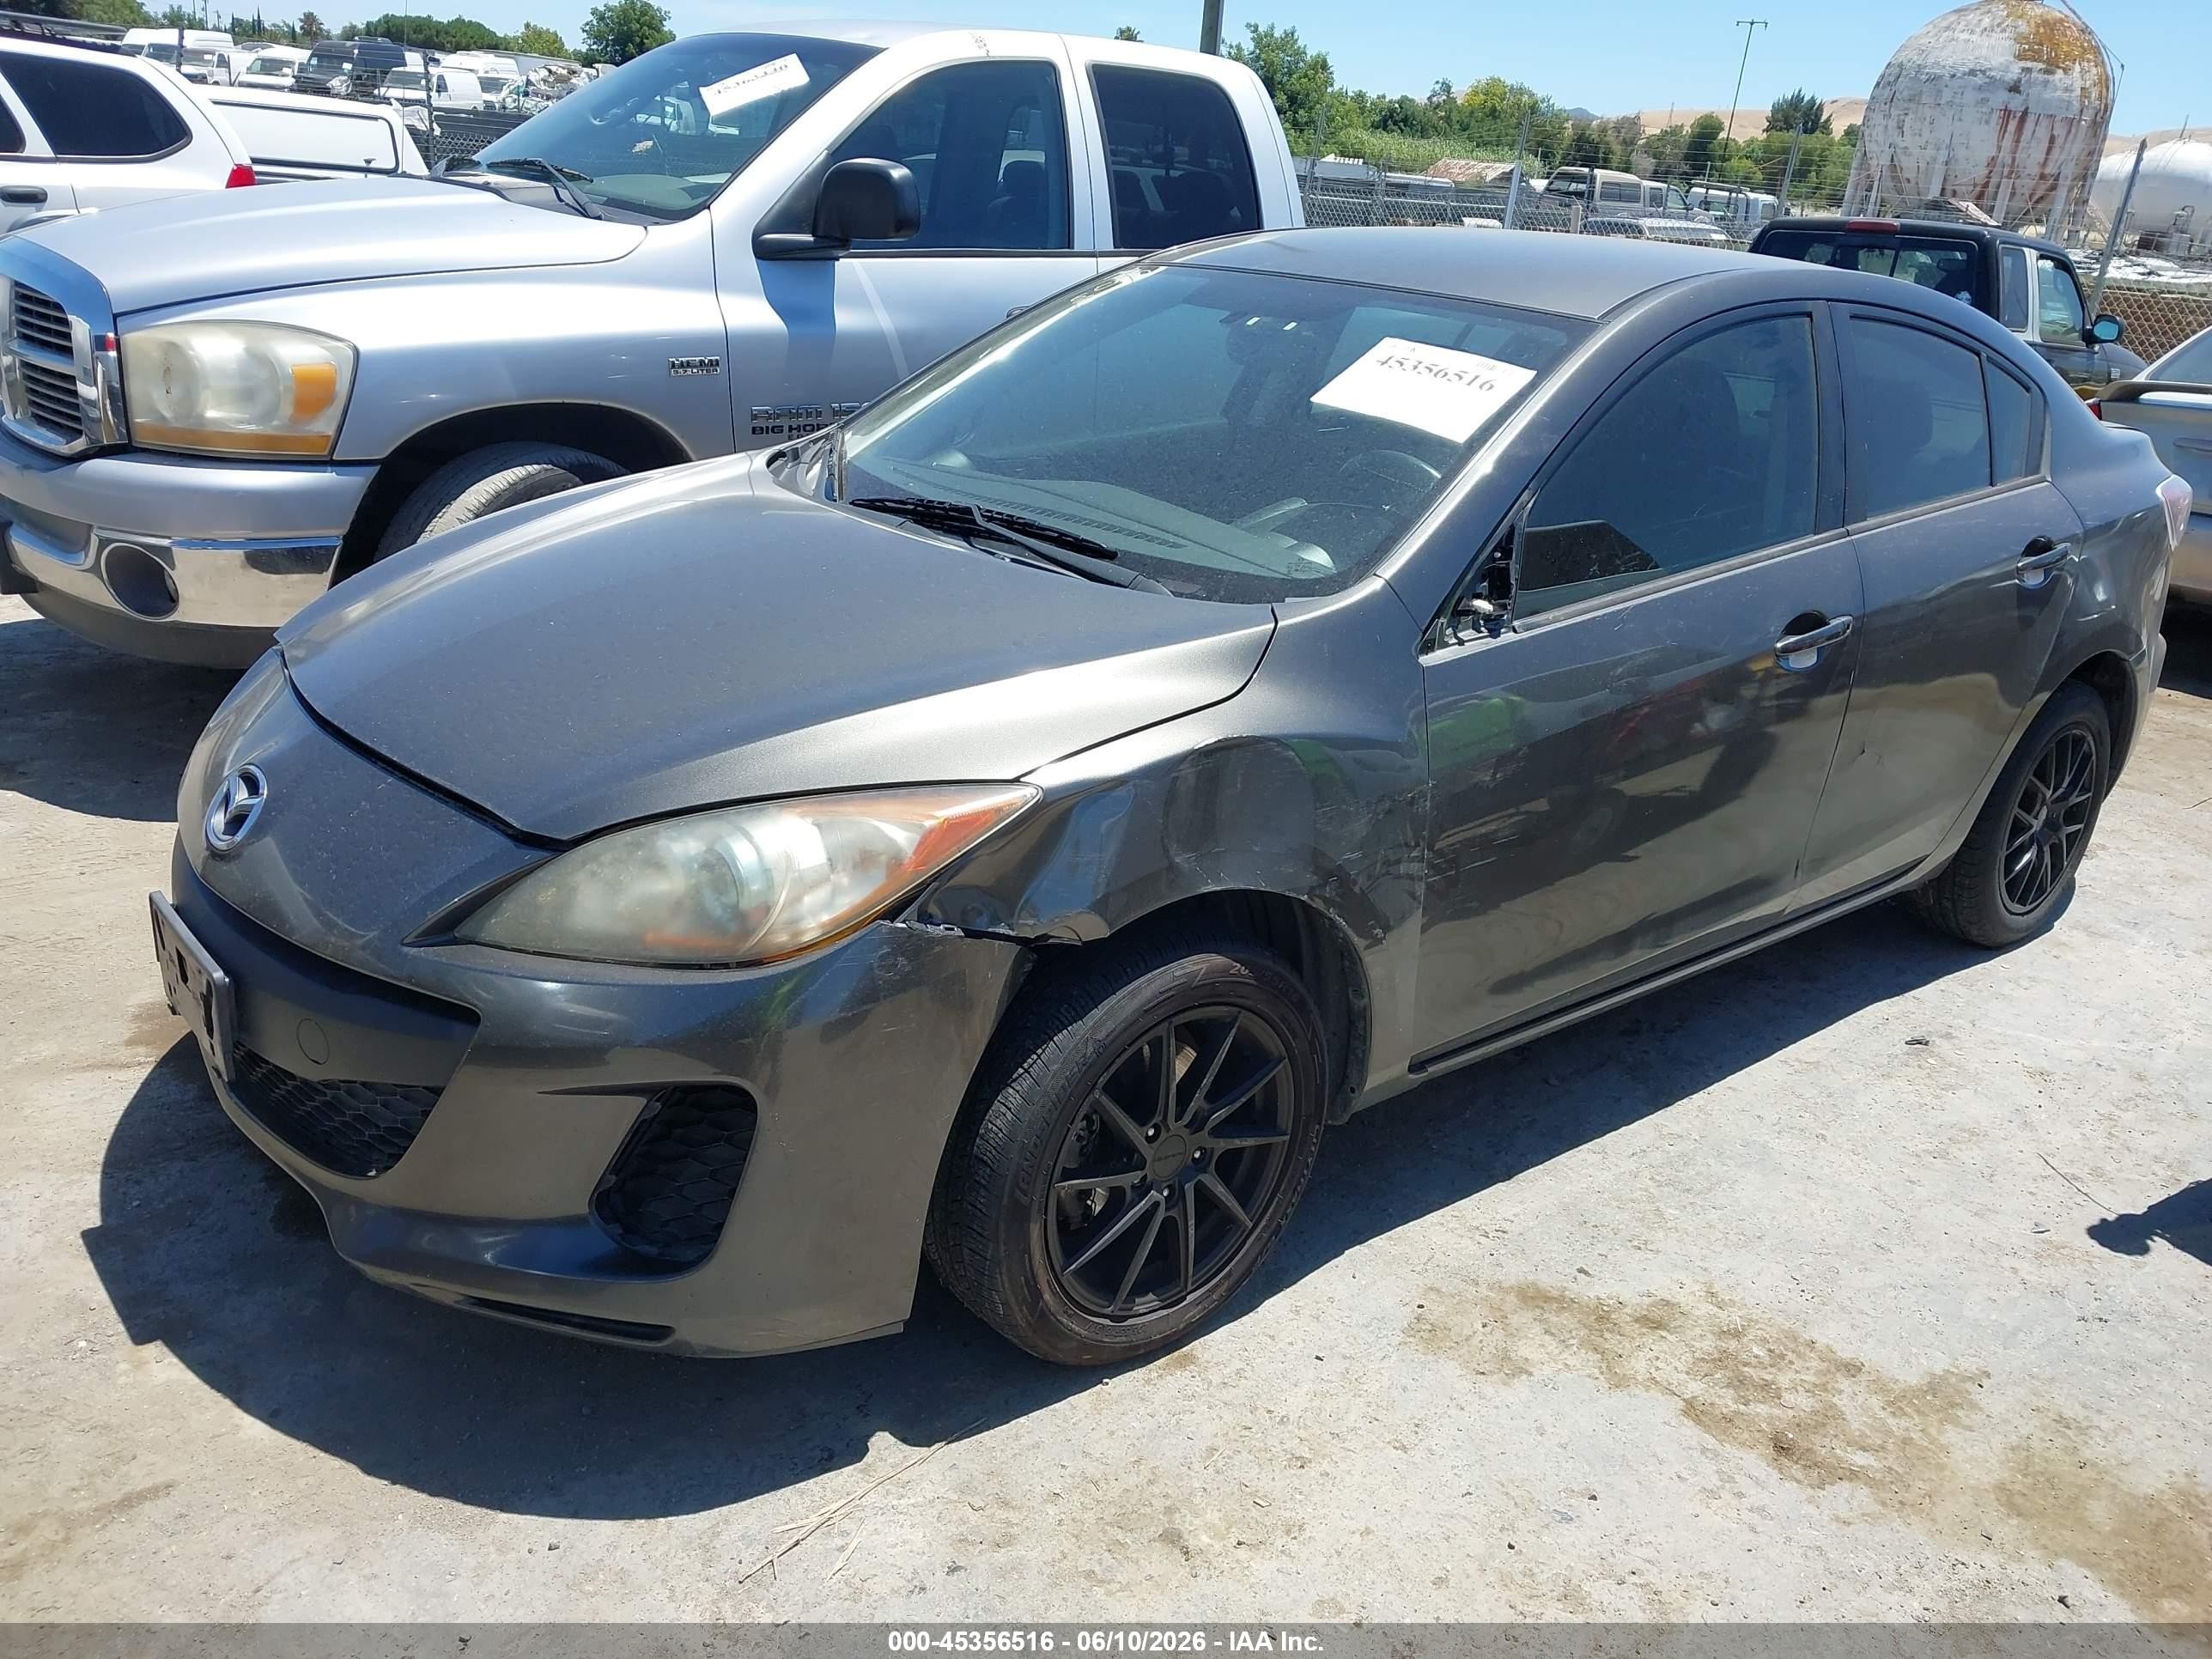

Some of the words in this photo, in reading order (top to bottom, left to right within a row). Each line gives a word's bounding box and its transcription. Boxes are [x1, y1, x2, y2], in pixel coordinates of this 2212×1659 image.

[671, 358, 720, 368] HEMI
[1376, 355, 1498, 392] 45356516
[751, 405, 823, 422] RAM
[751, 425, 784, 435] BIG
